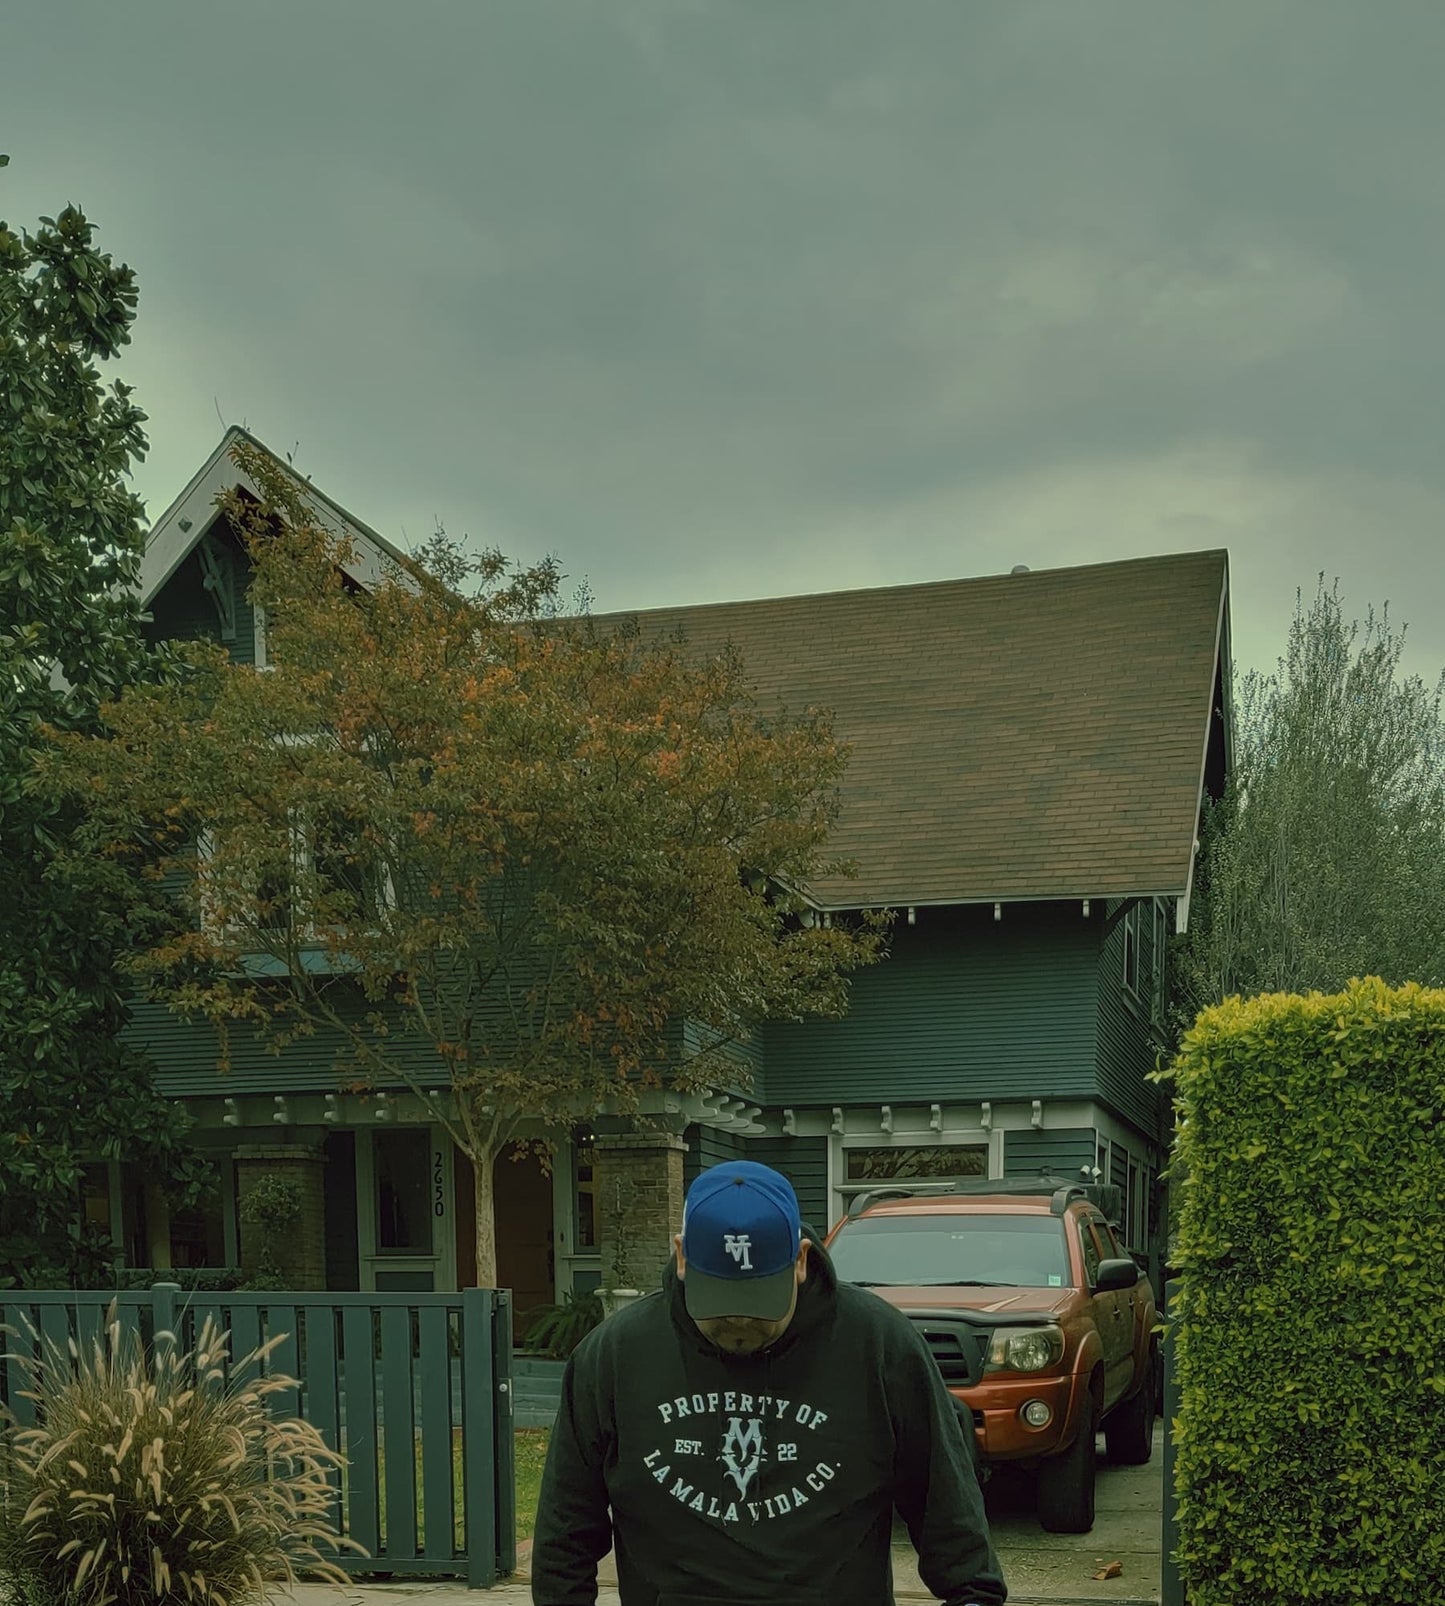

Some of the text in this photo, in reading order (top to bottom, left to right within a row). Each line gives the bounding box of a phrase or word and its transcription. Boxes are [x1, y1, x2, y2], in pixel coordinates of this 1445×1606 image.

[434, 1152, 444, 1216] 2650
[658, 1391, 828, 1430] PROPERTY OF
[674, 1439, 705, 1456] EST.
[777, 1443, 798, 1462] 22
[643, 1449, 842, 1522] LA MALA VIDA CO.
